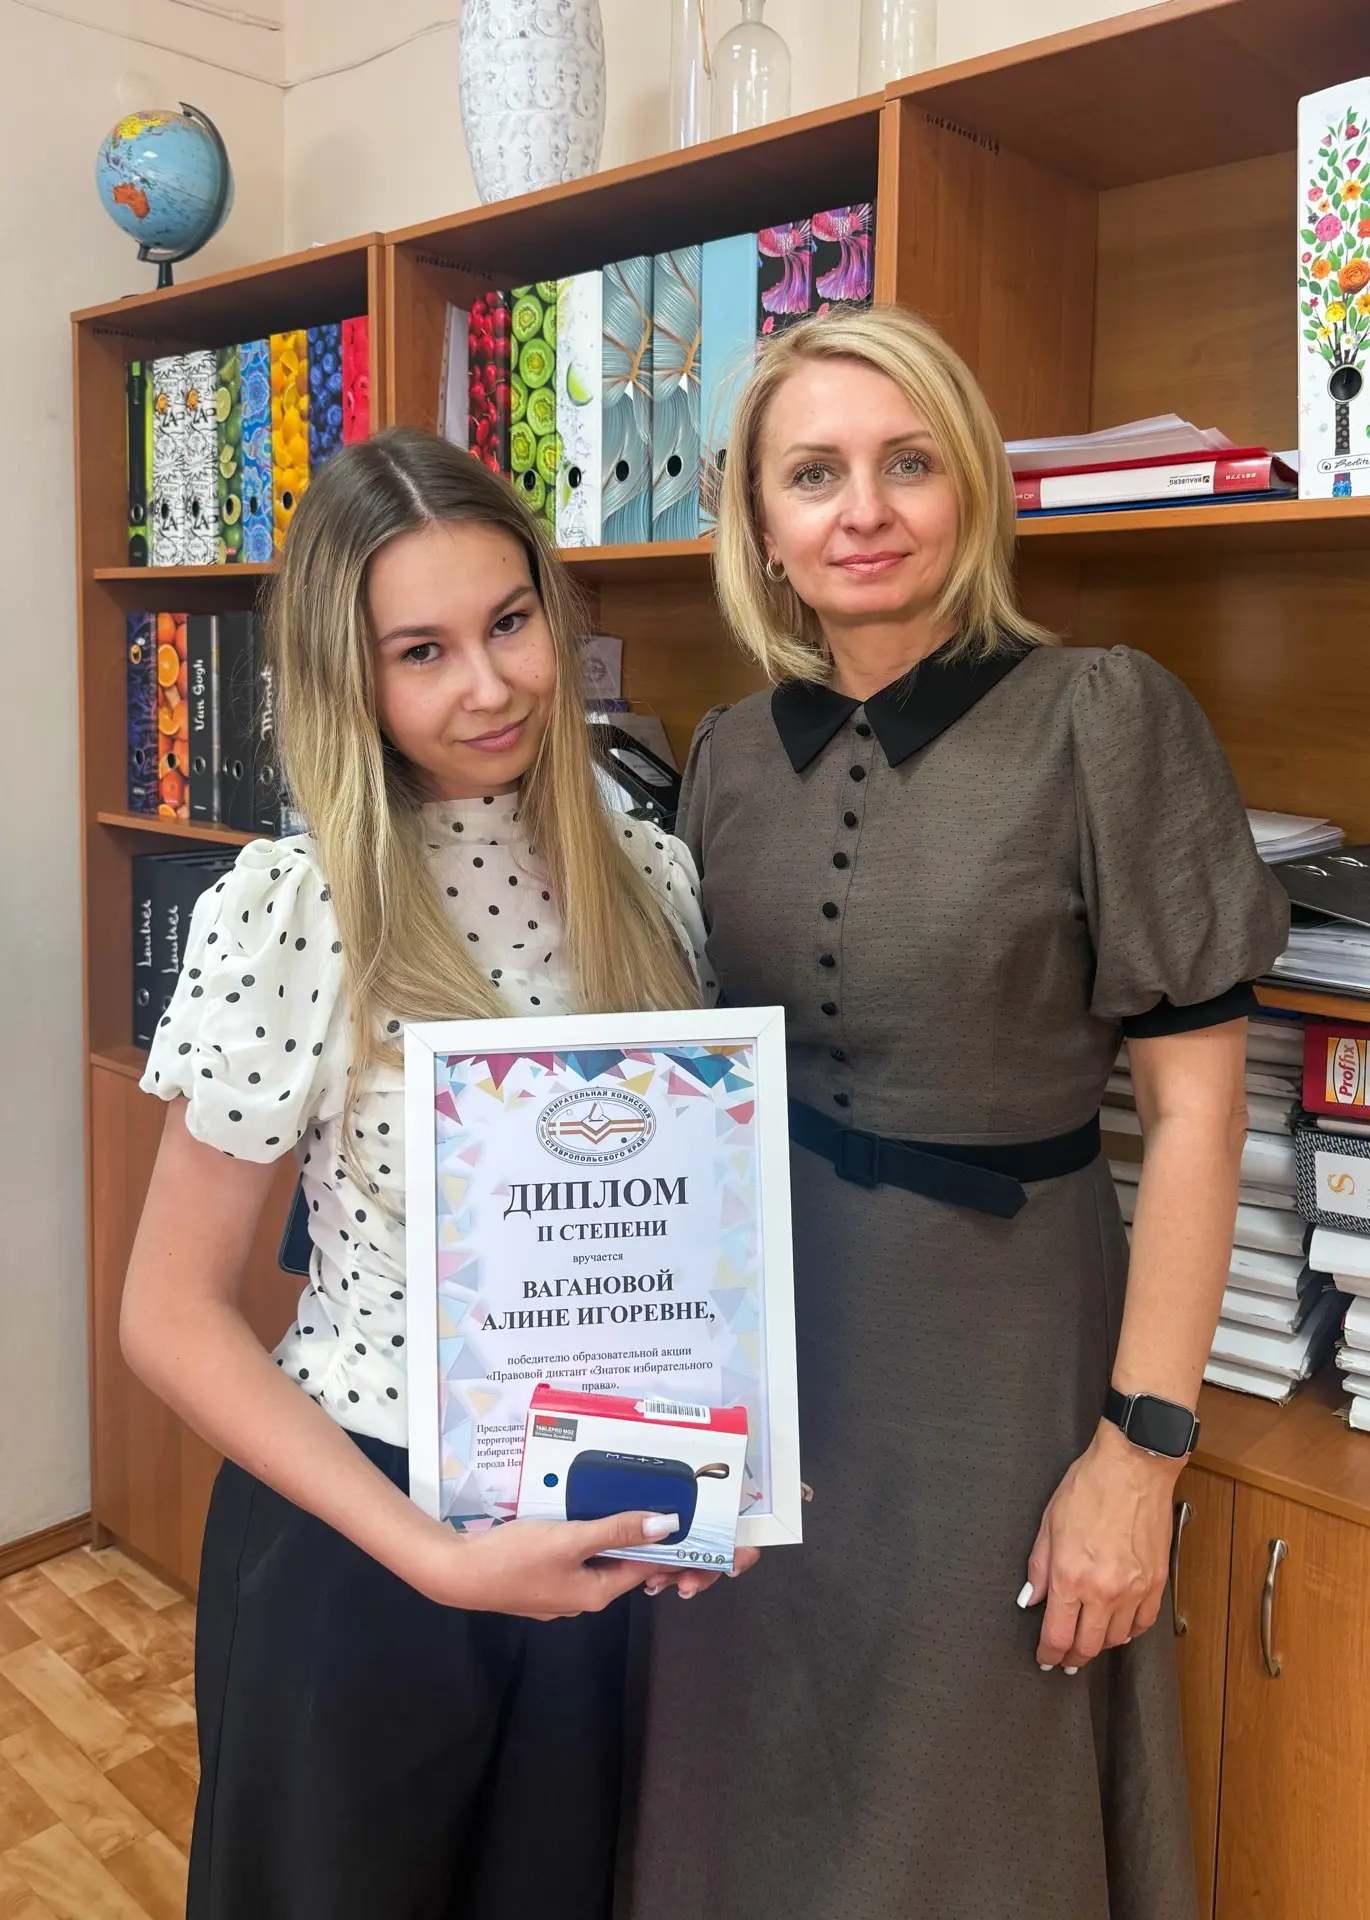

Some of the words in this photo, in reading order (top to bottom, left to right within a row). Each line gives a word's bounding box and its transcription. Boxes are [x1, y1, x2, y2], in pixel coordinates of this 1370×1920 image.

[1168, 476, 1202, 487] BRAUBERG
[193, 699, 205, 731] Van
[1339, 1044, 1356, 1097] Proffix
[541, 1090, 608, 1122] ИЗБИРАТЕЛЬНАЯ
[611, 1091, 652, 1119] КОМИССИЯ
[545, 1139, 625, 1163] СТАВРОПОЛЬСКОГО
[628, 1137, 647, 1154] КРАЯ
[503, 1176, 689, 1221] ДИПЛОМ
[559, 1219, 668, 1241] СТЕПЕНИ
[573, 1252, 624, 1265] вручается
[522, 1268, 675, 1299] ВАГАНОВОЙ
[481, 1308, 570, 1331] АЛИНЕ
[577, 1301, 715, 1326] ИГОРЕВНЕ,
[507, 1353, 570, 1366] победителю
[572, 1347, 658, 1364] образовательной
[661, 1346, 692, 1358] акции
[486, 1367, 543, 1383] «Правовой
[545, 1367, 587, 1379] диктант
[589, 1363, 631, 1376] «Знаток
[633, 1359, 713, 1374] избирательного
[581, 1380, 620, 1394] права».
[477, 1436, 524, 1446] территориа
[477, 1460, 505, 1470] города
